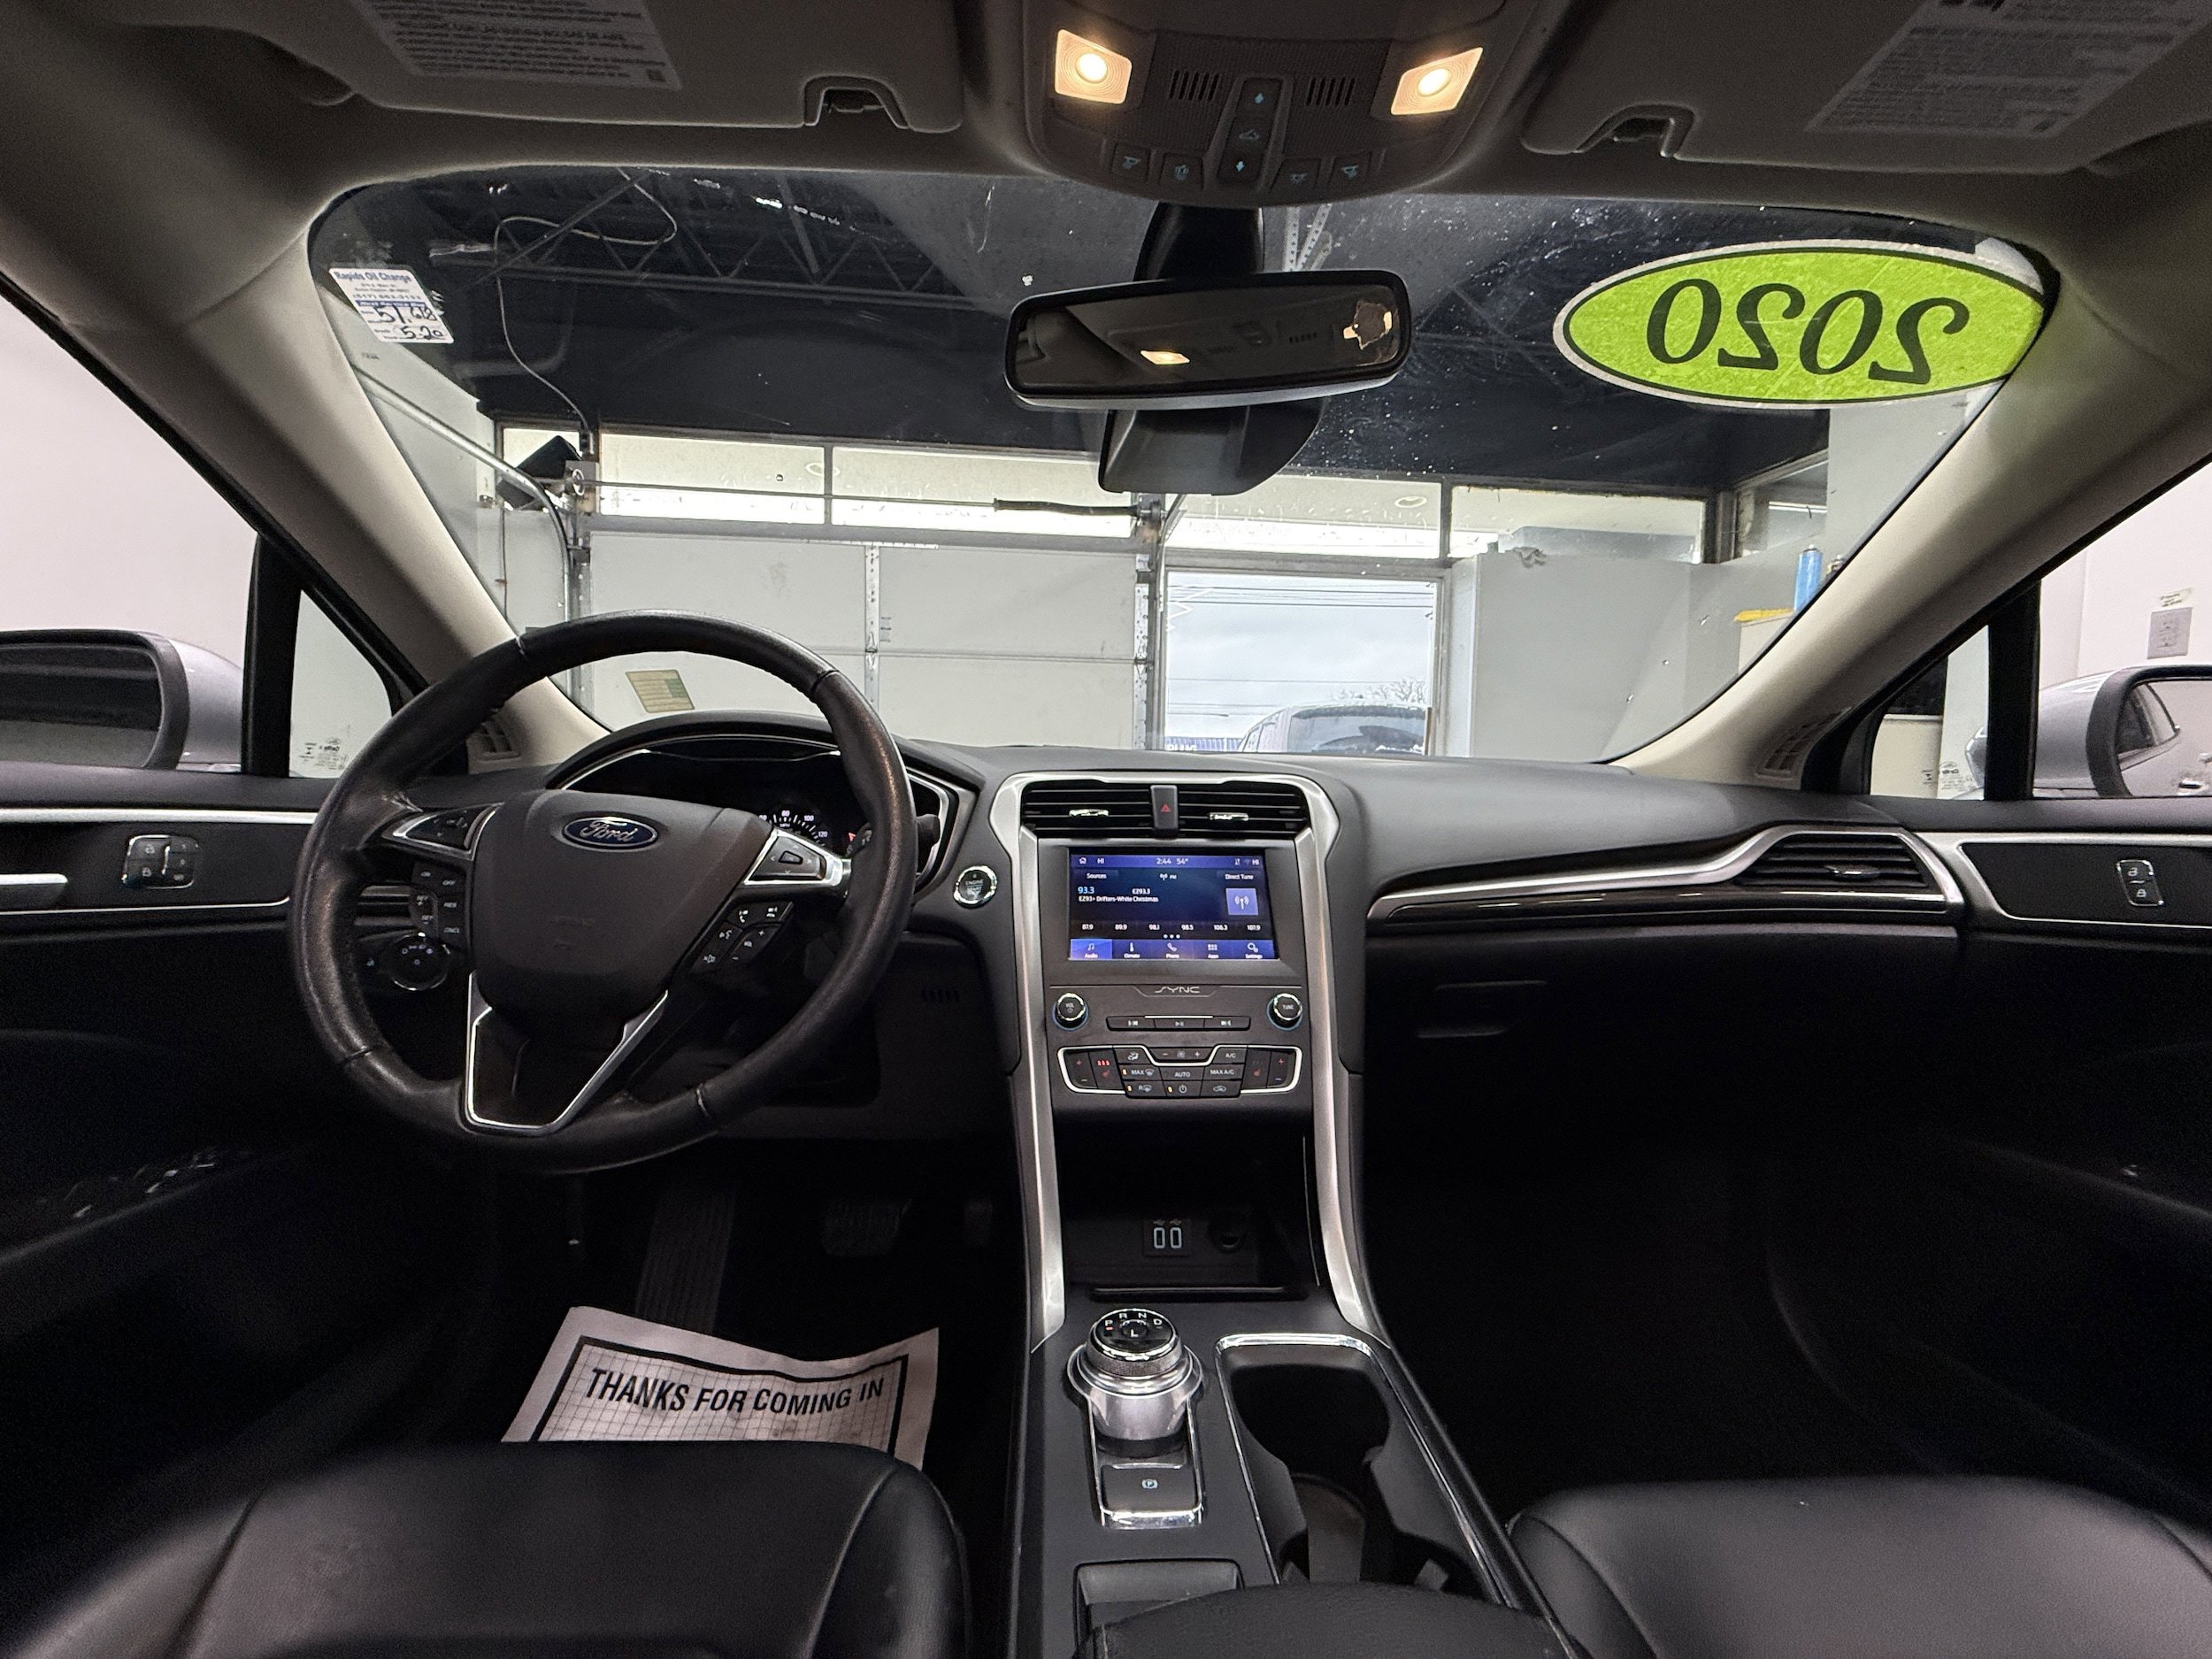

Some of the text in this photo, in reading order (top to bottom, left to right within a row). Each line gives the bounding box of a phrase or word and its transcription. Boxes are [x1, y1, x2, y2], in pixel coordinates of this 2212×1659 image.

[334, 271, 412, 283] Rapids Oil Change
[580, 818, 638, 842] Ford
[1078, 886, 1095, 895] 93.3
[1130, 1329, 1140, 1338] L
[586, 1368, 885, 1416] THANKS FOR COMING IN
